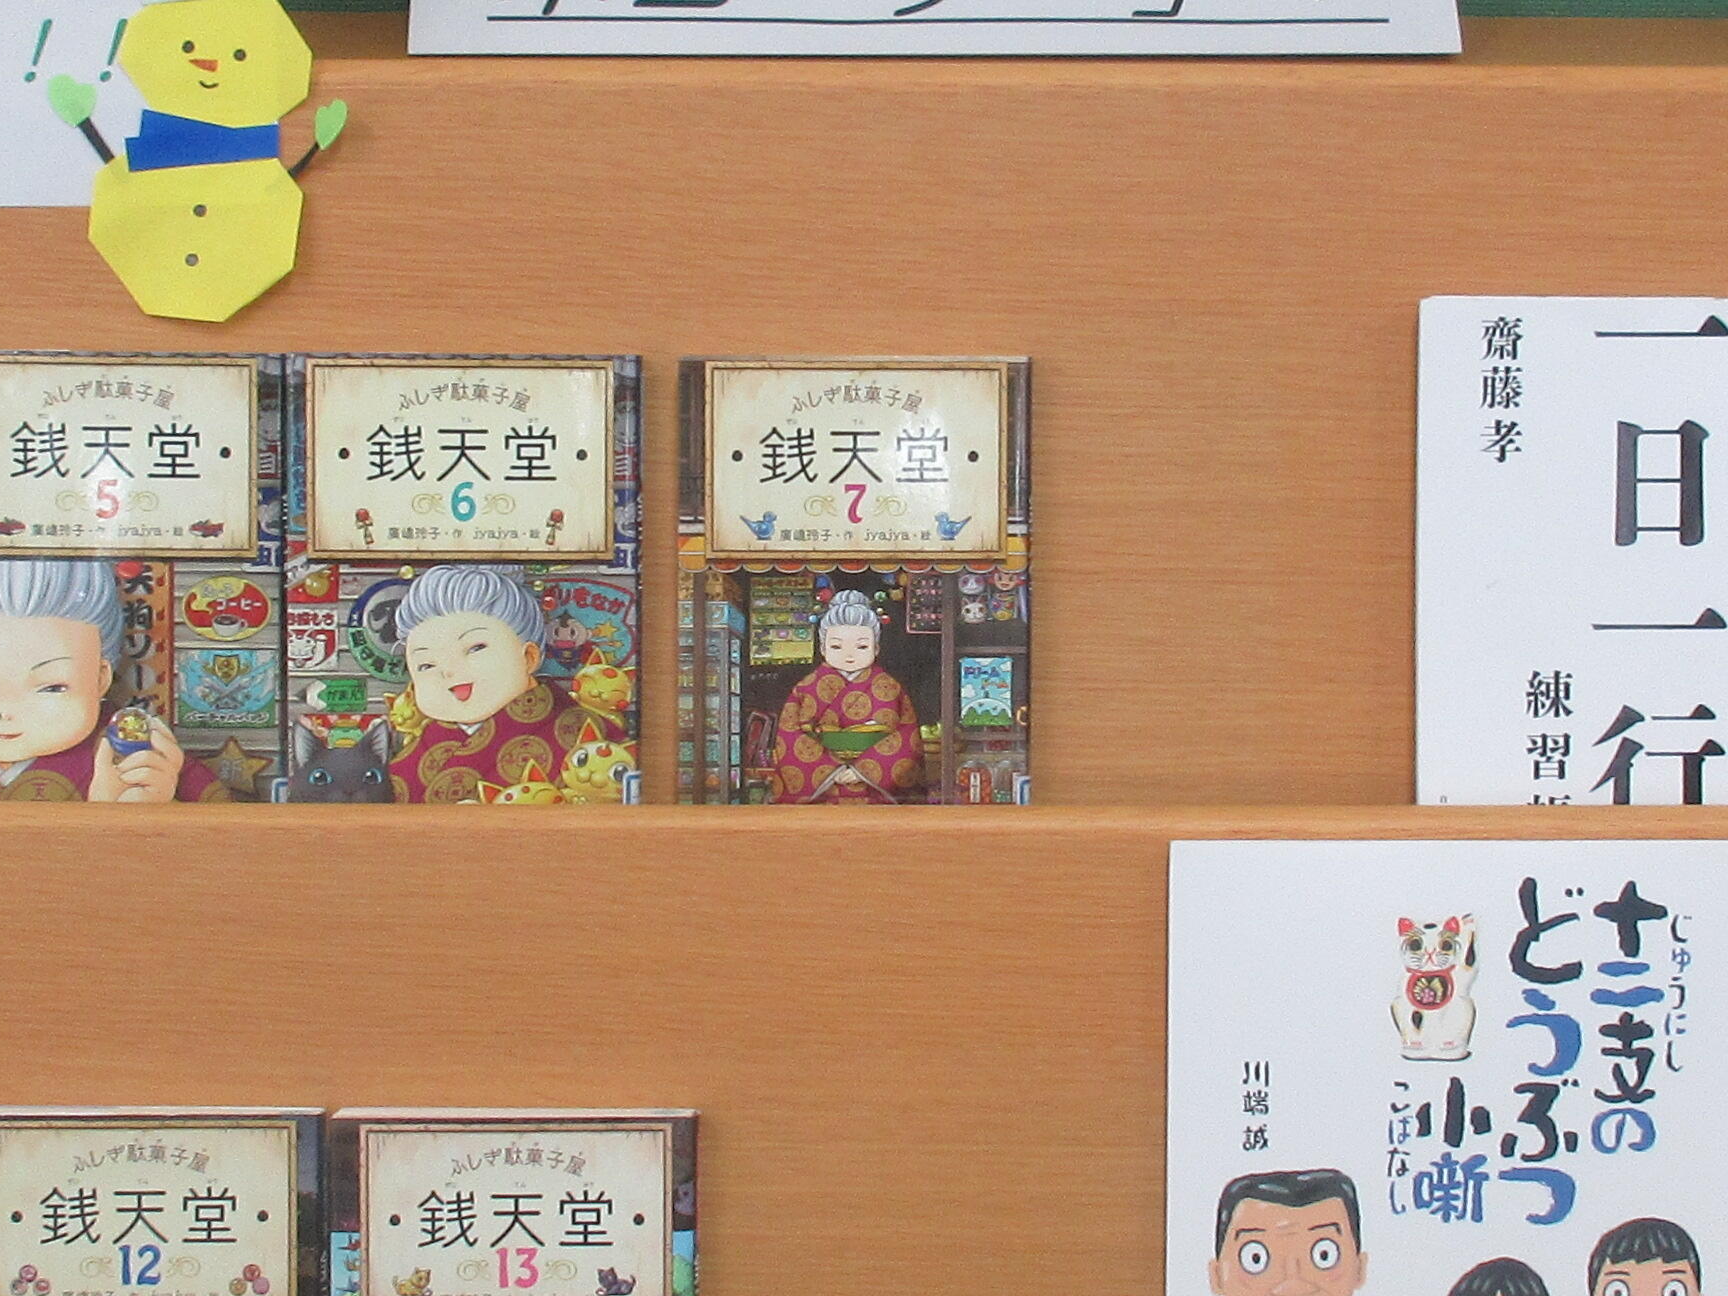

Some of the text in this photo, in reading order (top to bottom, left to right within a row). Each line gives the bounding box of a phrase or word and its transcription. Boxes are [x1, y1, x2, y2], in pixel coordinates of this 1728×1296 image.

[1479, 315, 1525, 464] 齋藤孝
[9, 420, 202, 480] 銭天堂
[365, 423, 558, 482] 銭天堂
[759, 425, 950, 485] 銭天堂
[95, 479, 122, 519] 5
[450, 482, 477, 522] 6
[843, 484, 867, 524] 7
[215, 597, 264, 612] コーヒー
[1524, 669, 1573, 805] 練習
[1589, 879, 1669, 1157] 十二支の
[1663, 912, 1693, 1075] じゅうにし
[1496, 876, 1586, 1227] どうぶつ
[1241, 1059, 1271, 1154] 川端誠
[1385, 1082, 1415, 1217] こばなし
[1412, 1076, 1493, 1226] 小噺
[38, 1185, 239, 1246] 銭天堂
[417, 1188, 615, 1248] 銭天堂
[118, 1243, 163, 1287] 12
[495, 1246, 541, 1289] 13
